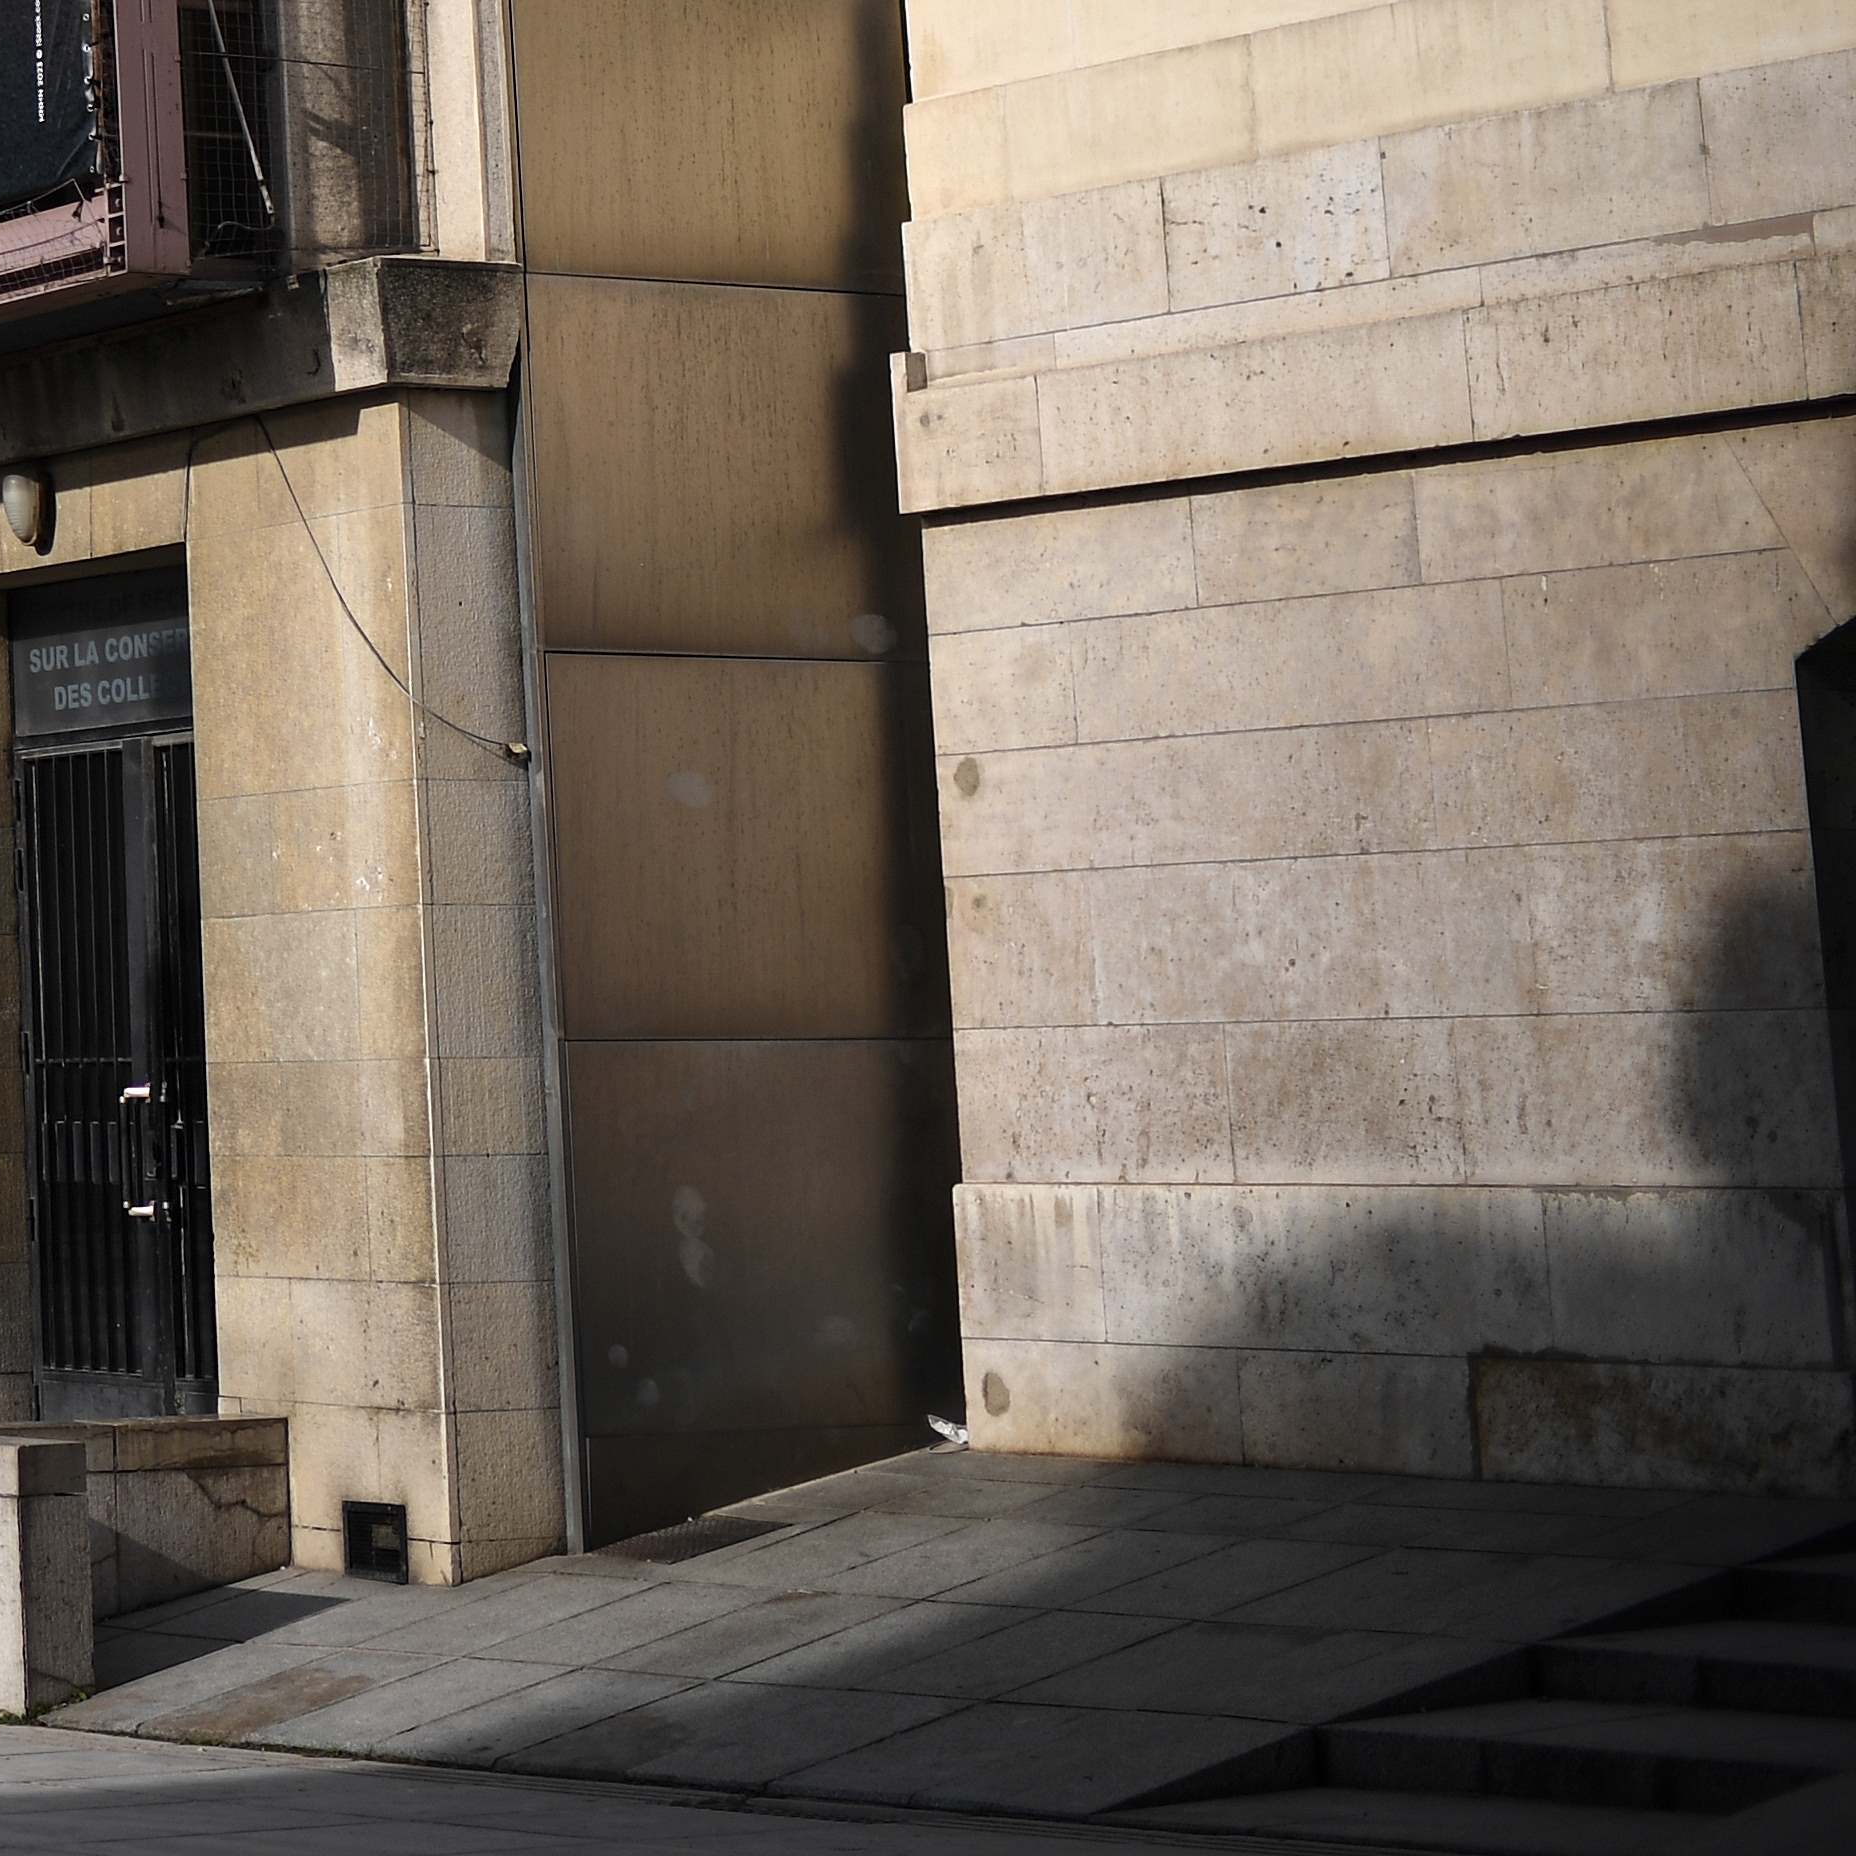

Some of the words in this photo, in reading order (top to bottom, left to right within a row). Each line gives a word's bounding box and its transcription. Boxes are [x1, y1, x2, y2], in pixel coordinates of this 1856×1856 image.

[29, 644, 70, 673] SUR
[73, 640, 99, 668] LA
[54, 682, 93, 712] DES
